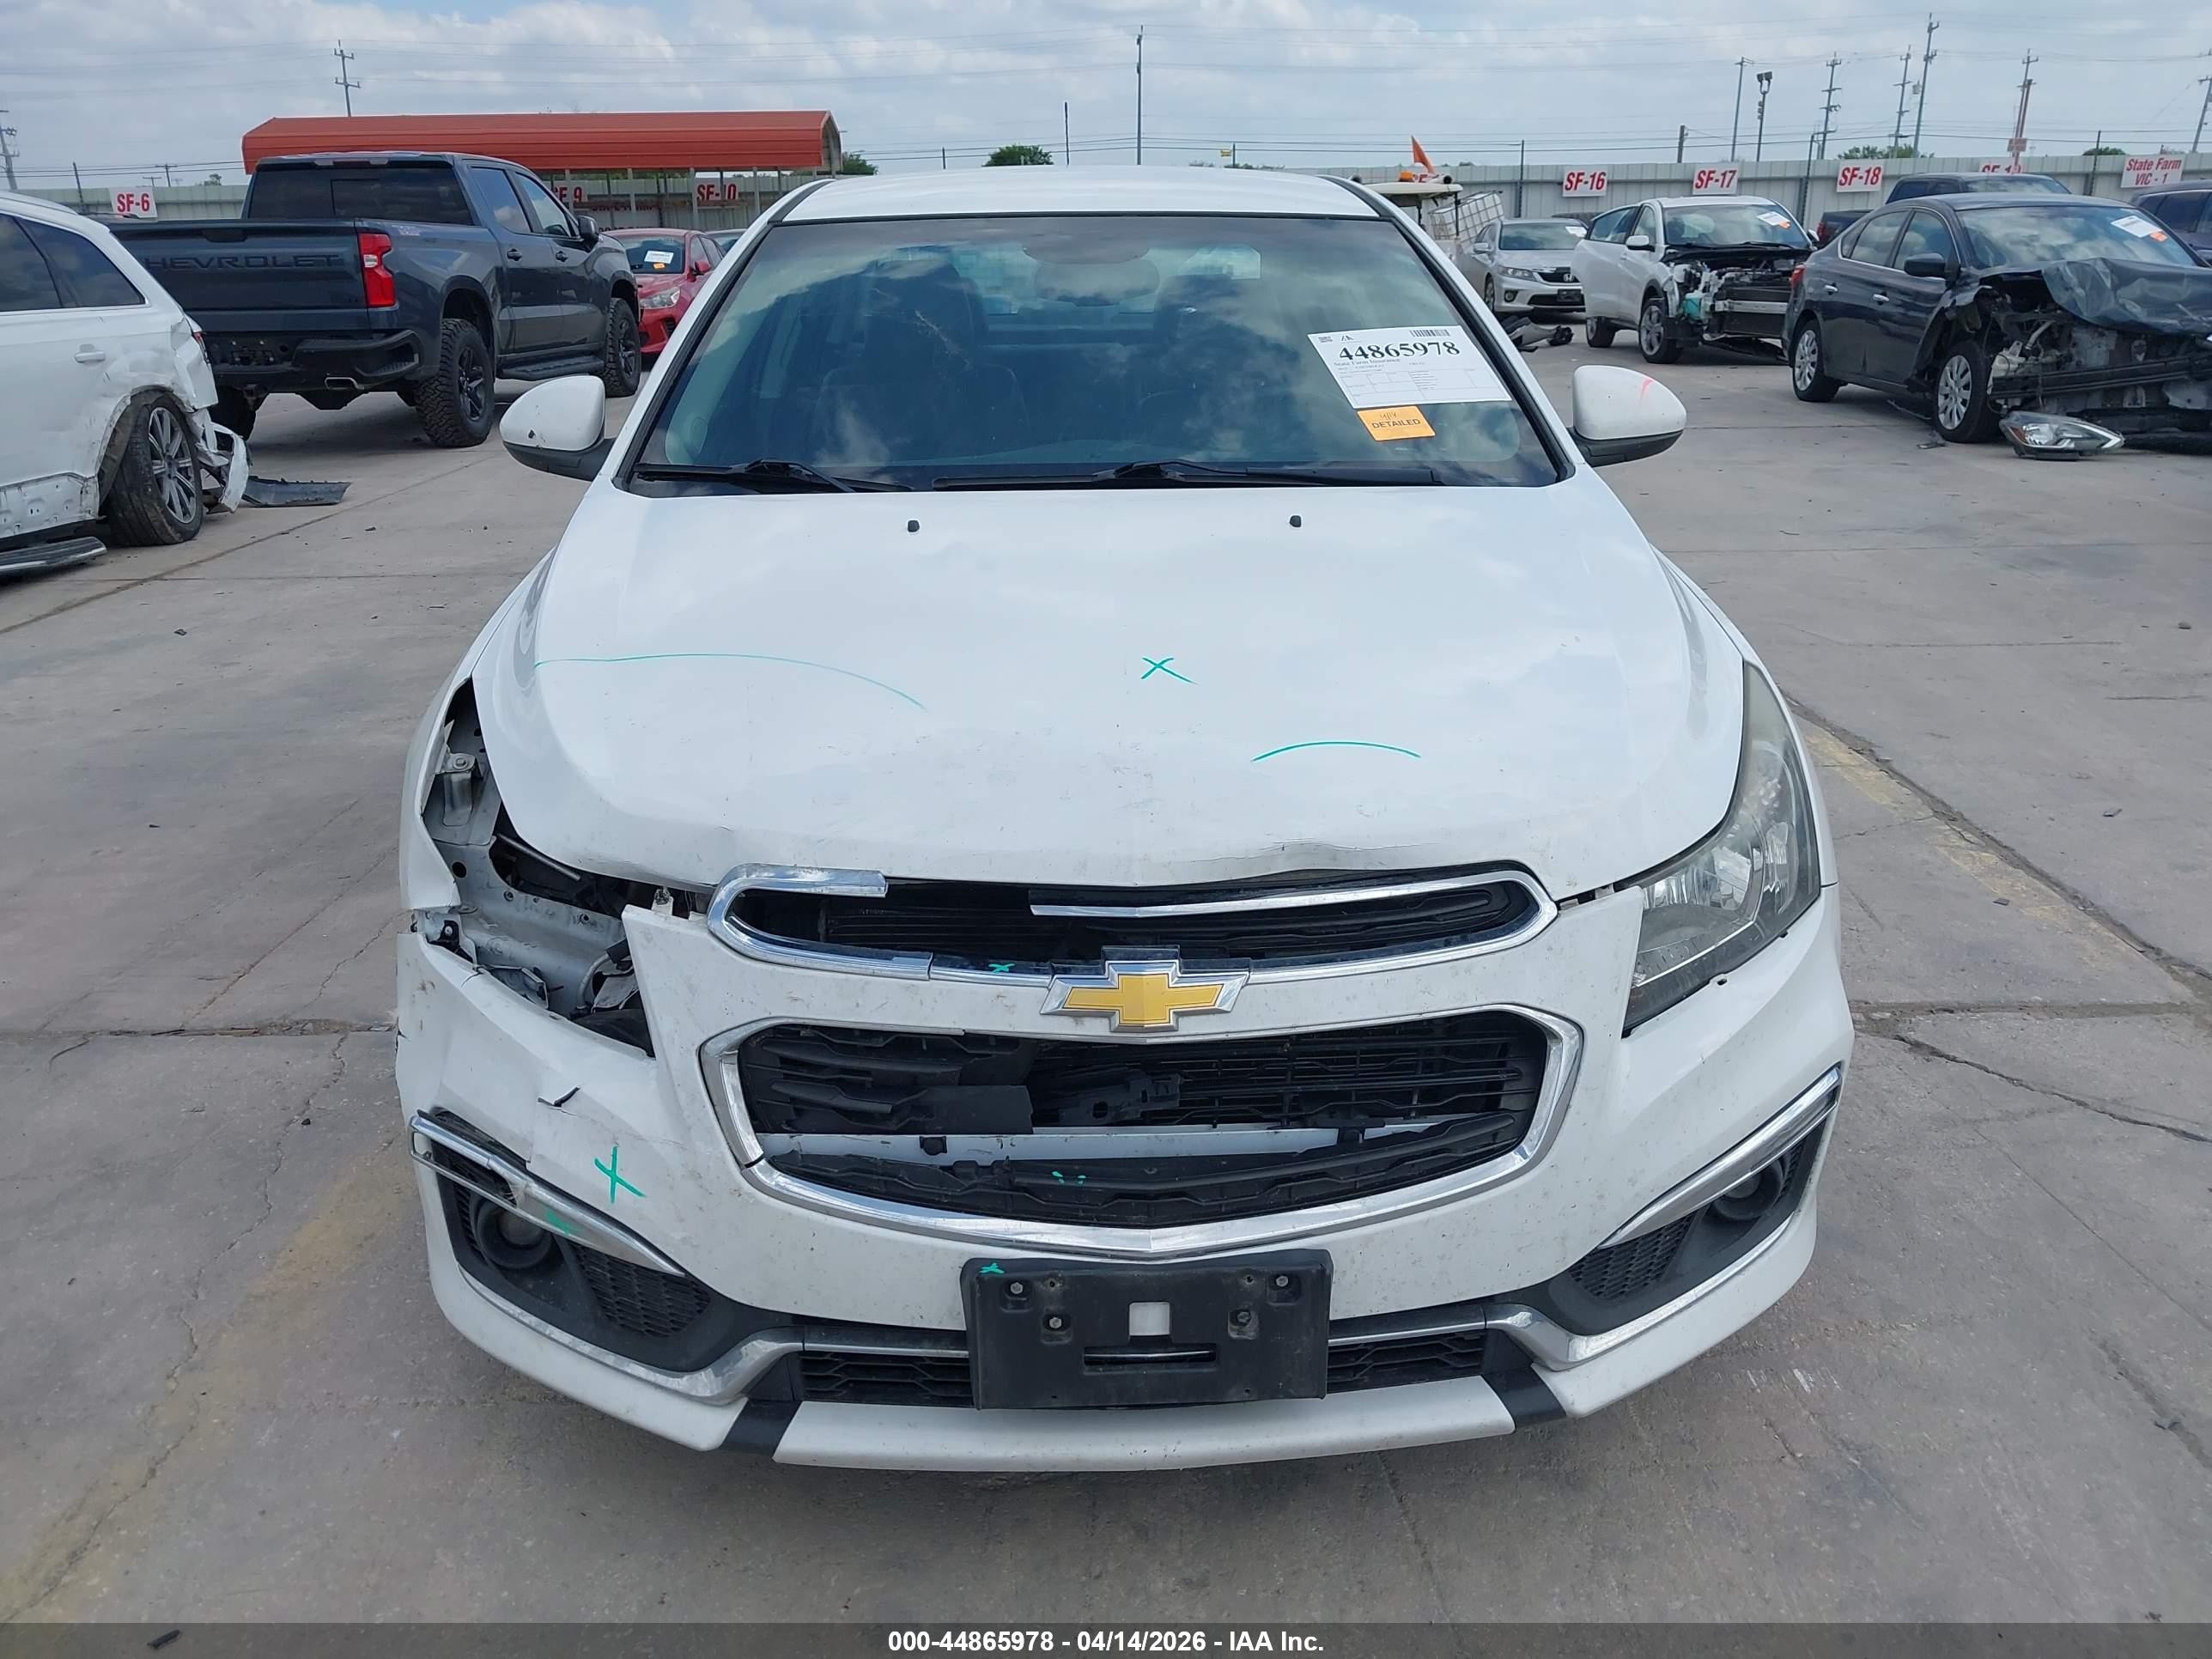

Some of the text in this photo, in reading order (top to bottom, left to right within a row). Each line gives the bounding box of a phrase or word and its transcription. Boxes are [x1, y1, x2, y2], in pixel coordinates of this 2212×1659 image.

[2126, 157, 2182, 171] State Farm
[1565, 171, 1607, 191] SF-16
[1695, 169, 1737, 189] SF-17
[1838, 167, 1881, 186] SF-18
[2135, 173, 2153, 185] VIC
[2162, 173, 2169, 185] 1
[117, 192, 150, 213] SF-6
[554, 185, 582, 202] F9
[144, 254, 339, 270] HEVROLET
[1340, 341, 1461, 361] 44865978
[1371, 418, 1421, 429] DETAILED
